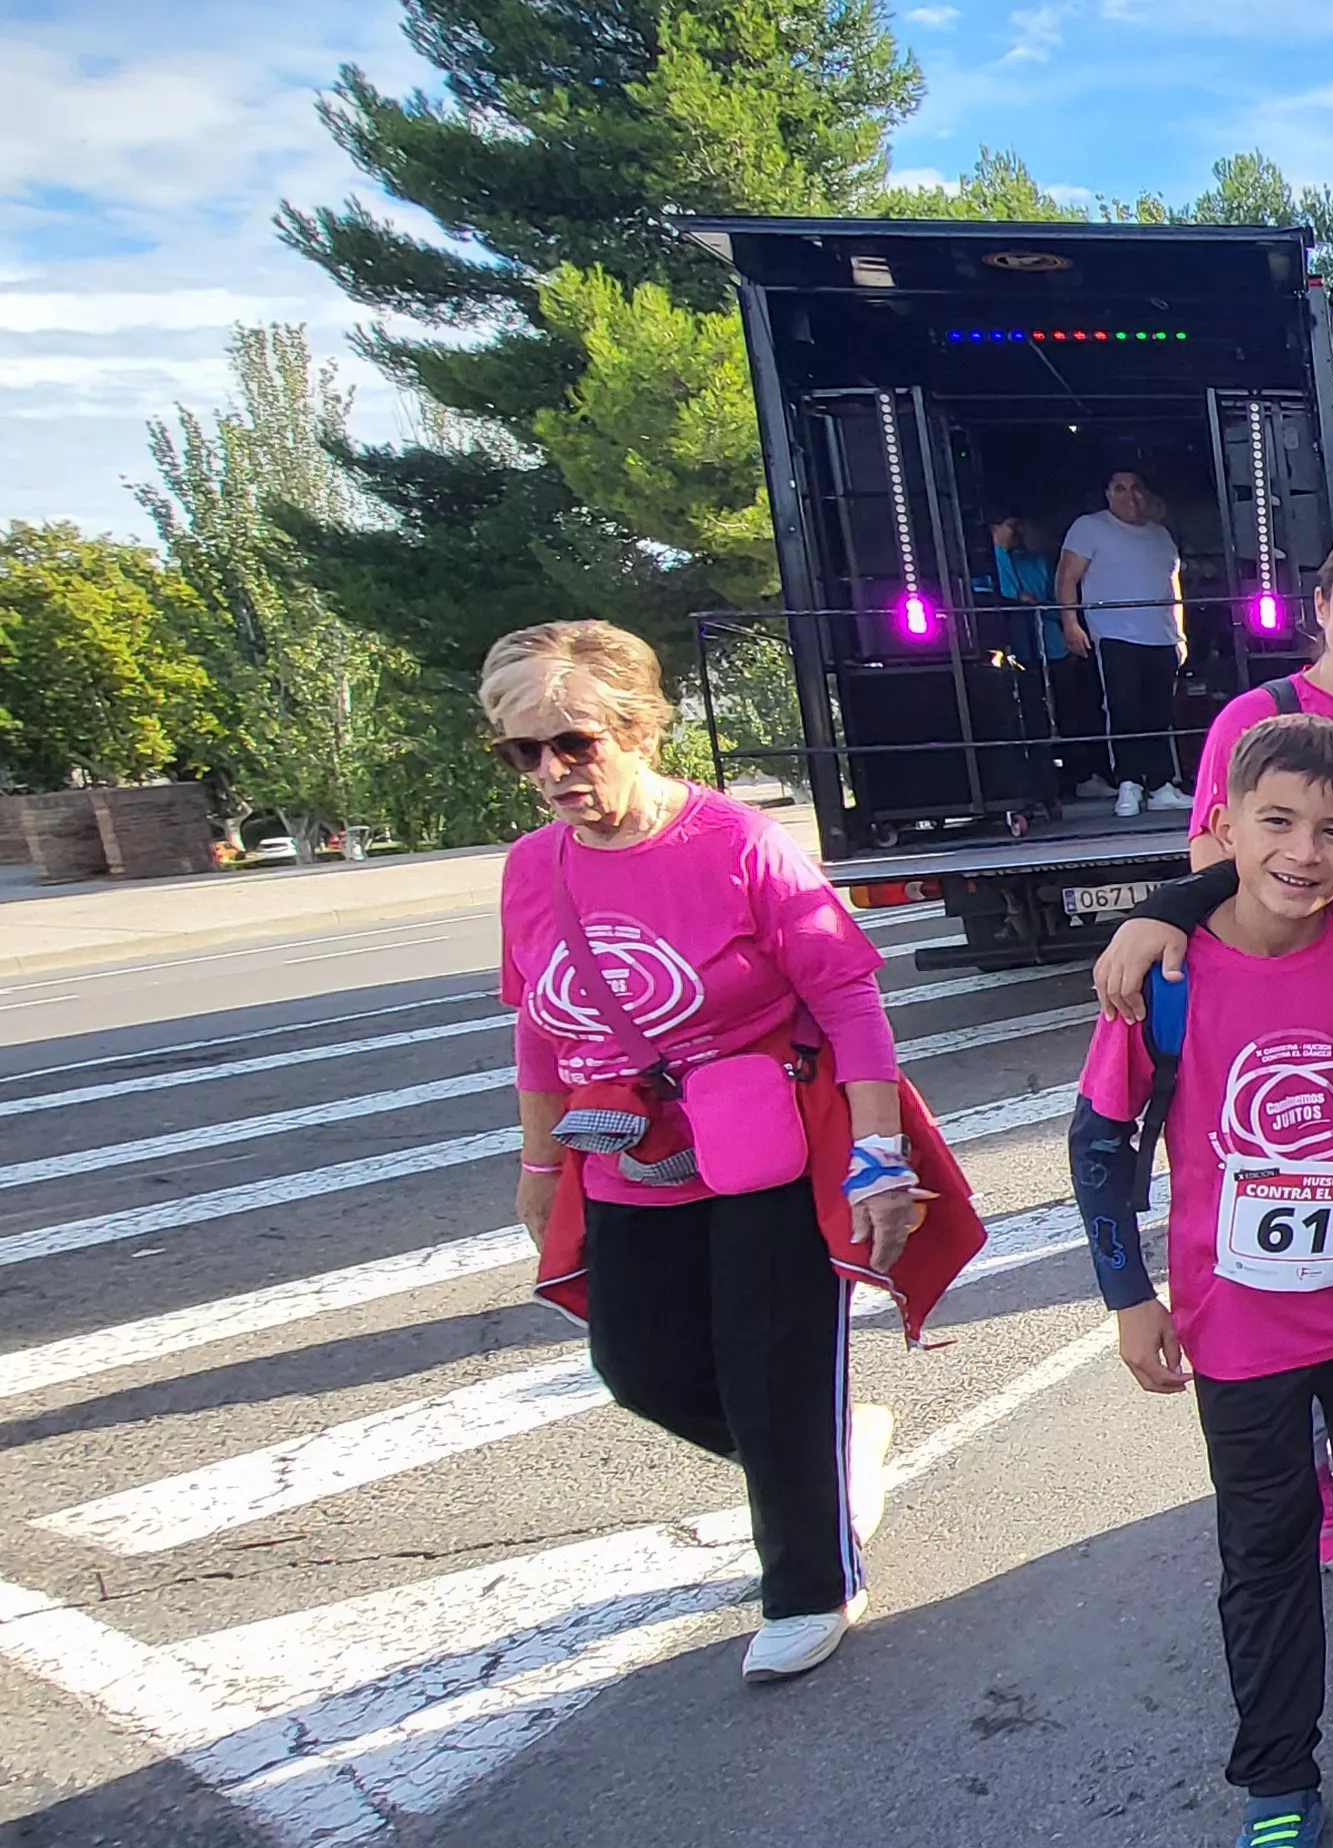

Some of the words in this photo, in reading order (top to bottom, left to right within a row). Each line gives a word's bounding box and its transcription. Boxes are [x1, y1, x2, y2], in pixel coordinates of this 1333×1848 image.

[1272, 1105, 1322, 1131] JUNTOS
[1246, 1184, 1312, 1200] CONTRA
[1315, 1187, 1331, 1200] EL
